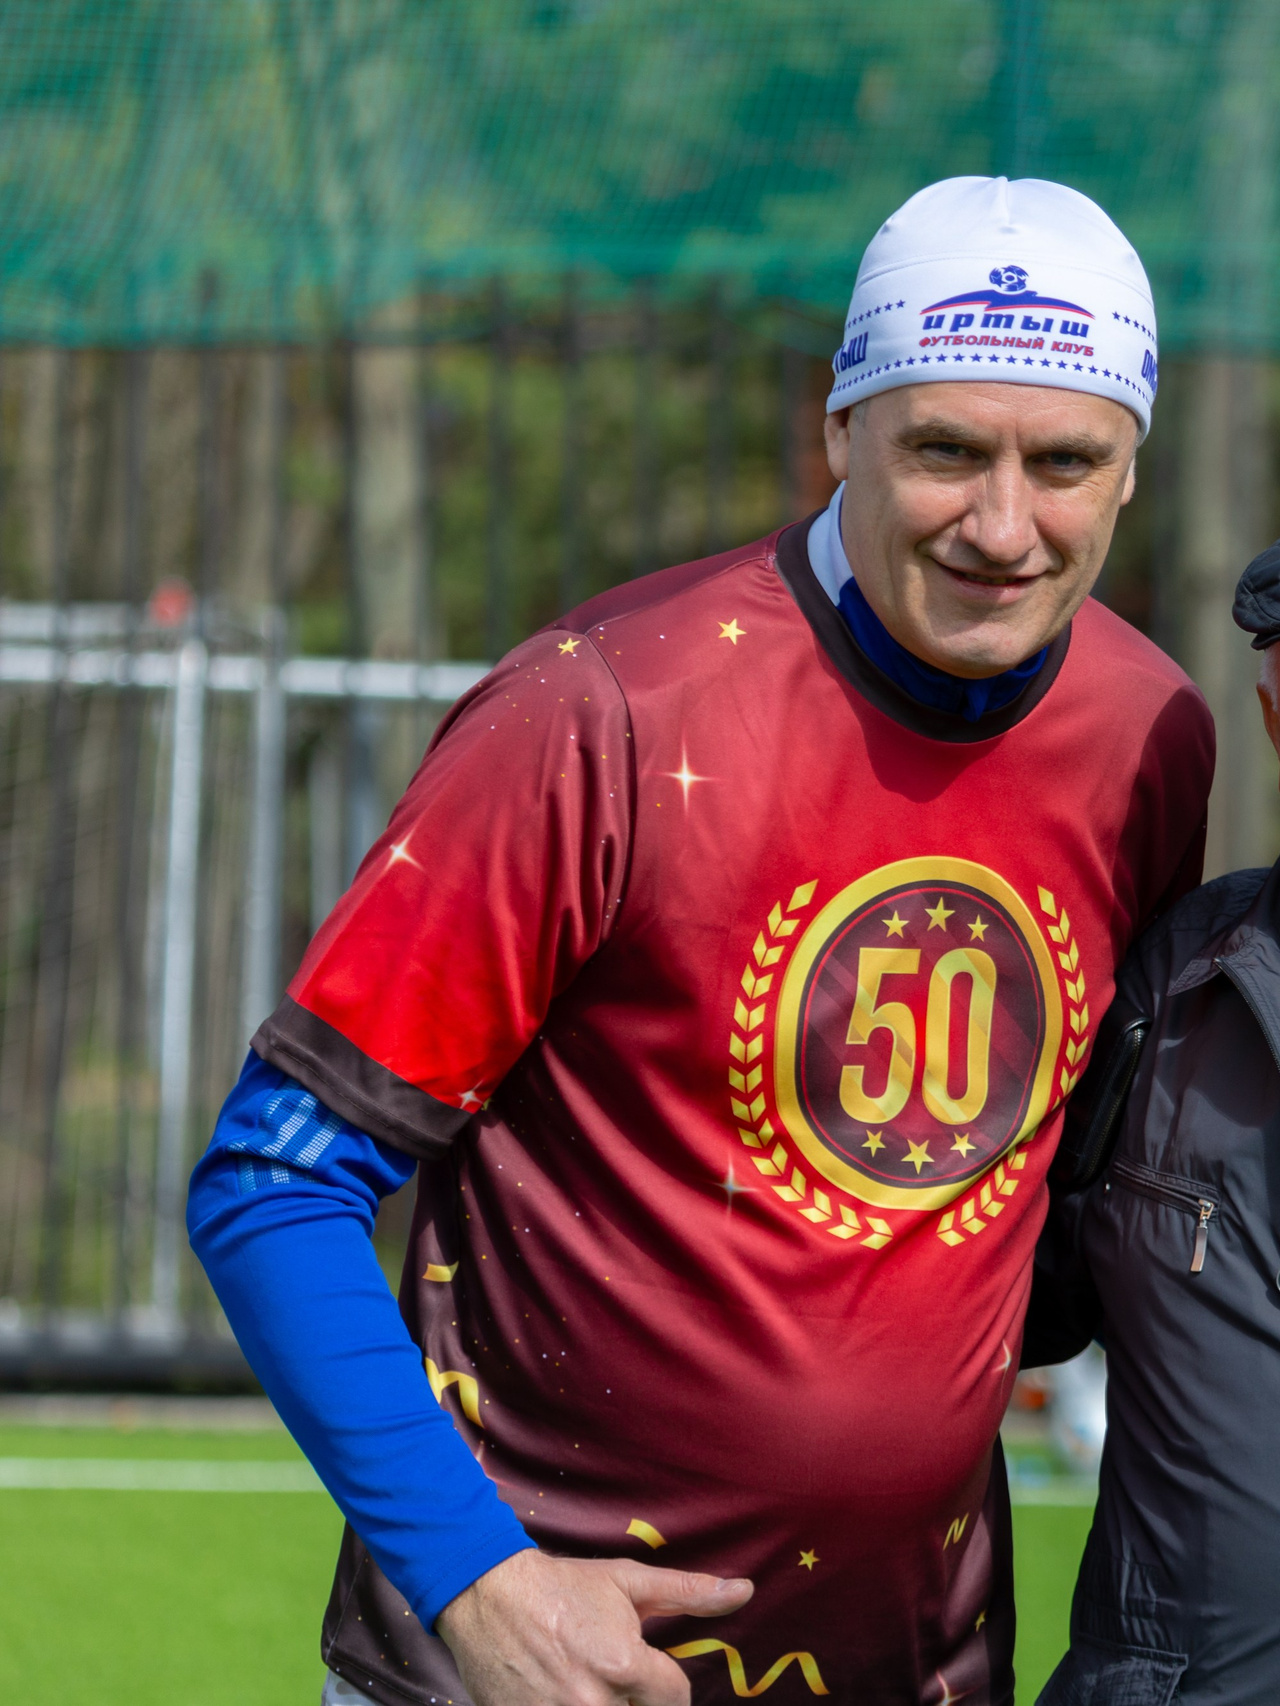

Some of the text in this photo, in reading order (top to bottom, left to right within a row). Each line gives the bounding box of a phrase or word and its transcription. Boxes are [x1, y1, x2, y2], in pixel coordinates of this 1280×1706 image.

[918, 335, 1095, 357] ФУТБОЛЬНЫЙ КЛУБ
[839, 947, 998, 1126] 50
